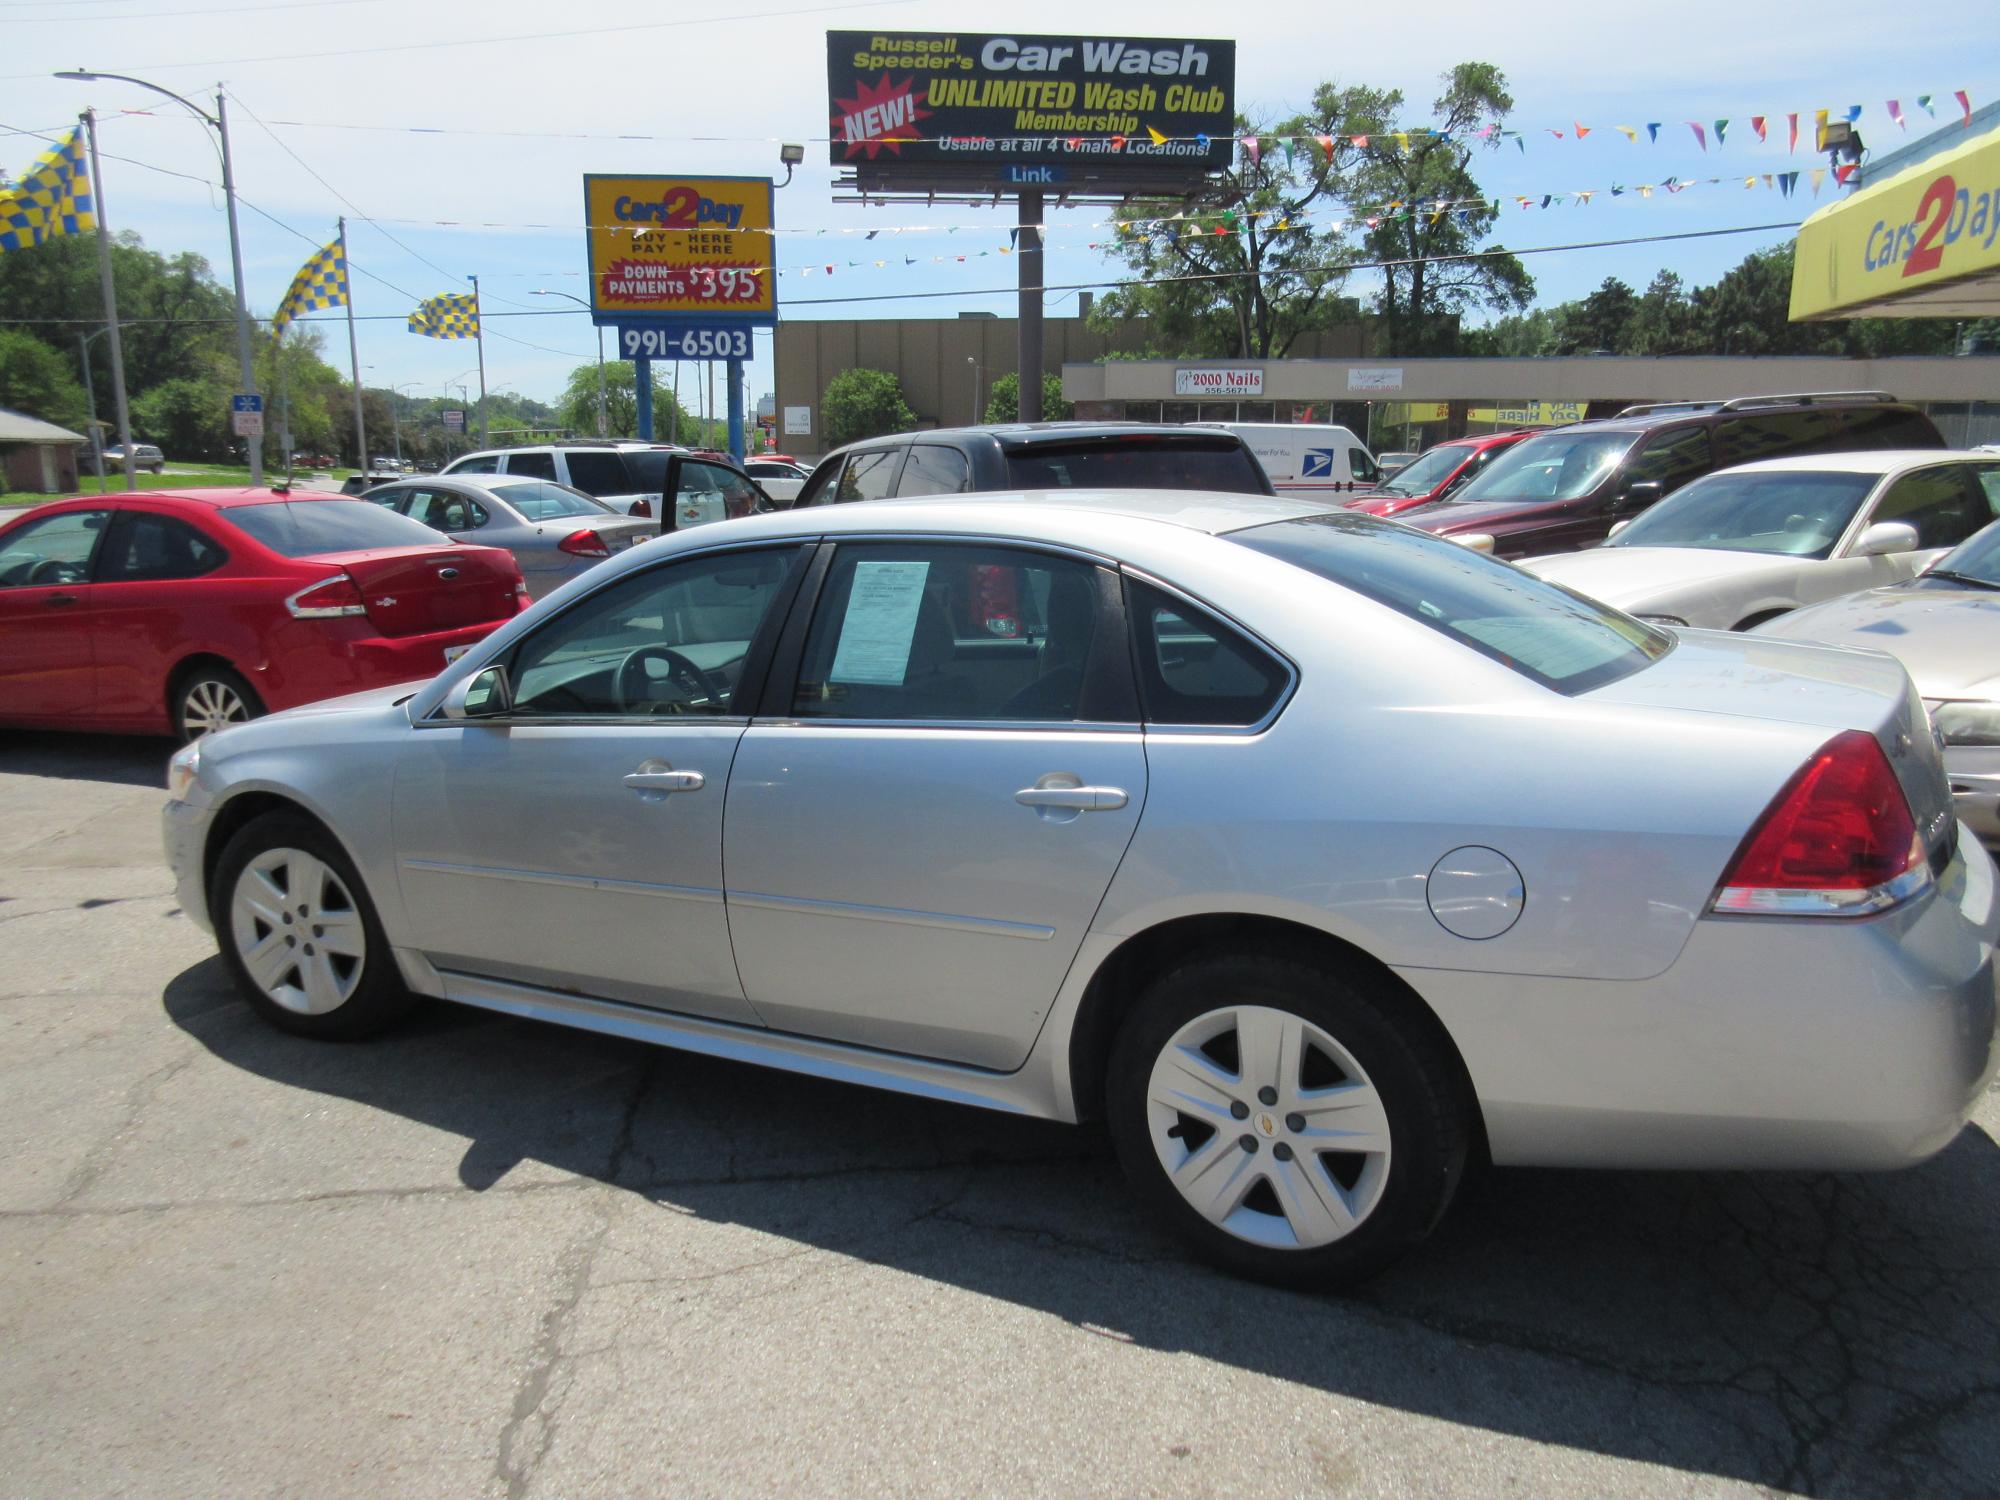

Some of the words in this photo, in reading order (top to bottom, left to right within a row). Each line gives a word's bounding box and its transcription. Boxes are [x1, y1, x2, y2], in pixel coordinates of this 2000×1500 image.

[870, 36, 957, 53] Russell
[853, 52, 974, 71] Speeder's
[981, 38, 1073, 72] Car
[1082, 41, 1209, 76] Wash
[927, 78, 1077, 109] UNLIMITED
[1083, 82, 1157, 112] Wash
[1164, 84, 1225, 114] Club
[843, 93, 916, 146] NEW!
[1015, 110, 1139, 135] Membership
[938, 136, 995, 151] Usable
[1000, 140, 1018, 152] at
[1021, 138, 1043, 152] all
[1047, 137, 1058, 152] 4
[1062, 137, 1121, 154] Omaha
[1125, 139, 1211, 157] Locations!
[1012, 166, 1053, 183] Link
[631, 233, 666, 243] BUY
[688, 234, 733, 244] HERE
[631, 244, 666, 254] PAY
[688, 245, 733, 255] HERE
[624, 265, 668, 279] DOWN
[609, 280, 685, 295] PAYMENTS
[624, 329, 747, 357] 991-6503
[1193, 373, 1222, 386] 2000
[1226, 371, 1260, 386] Nails
